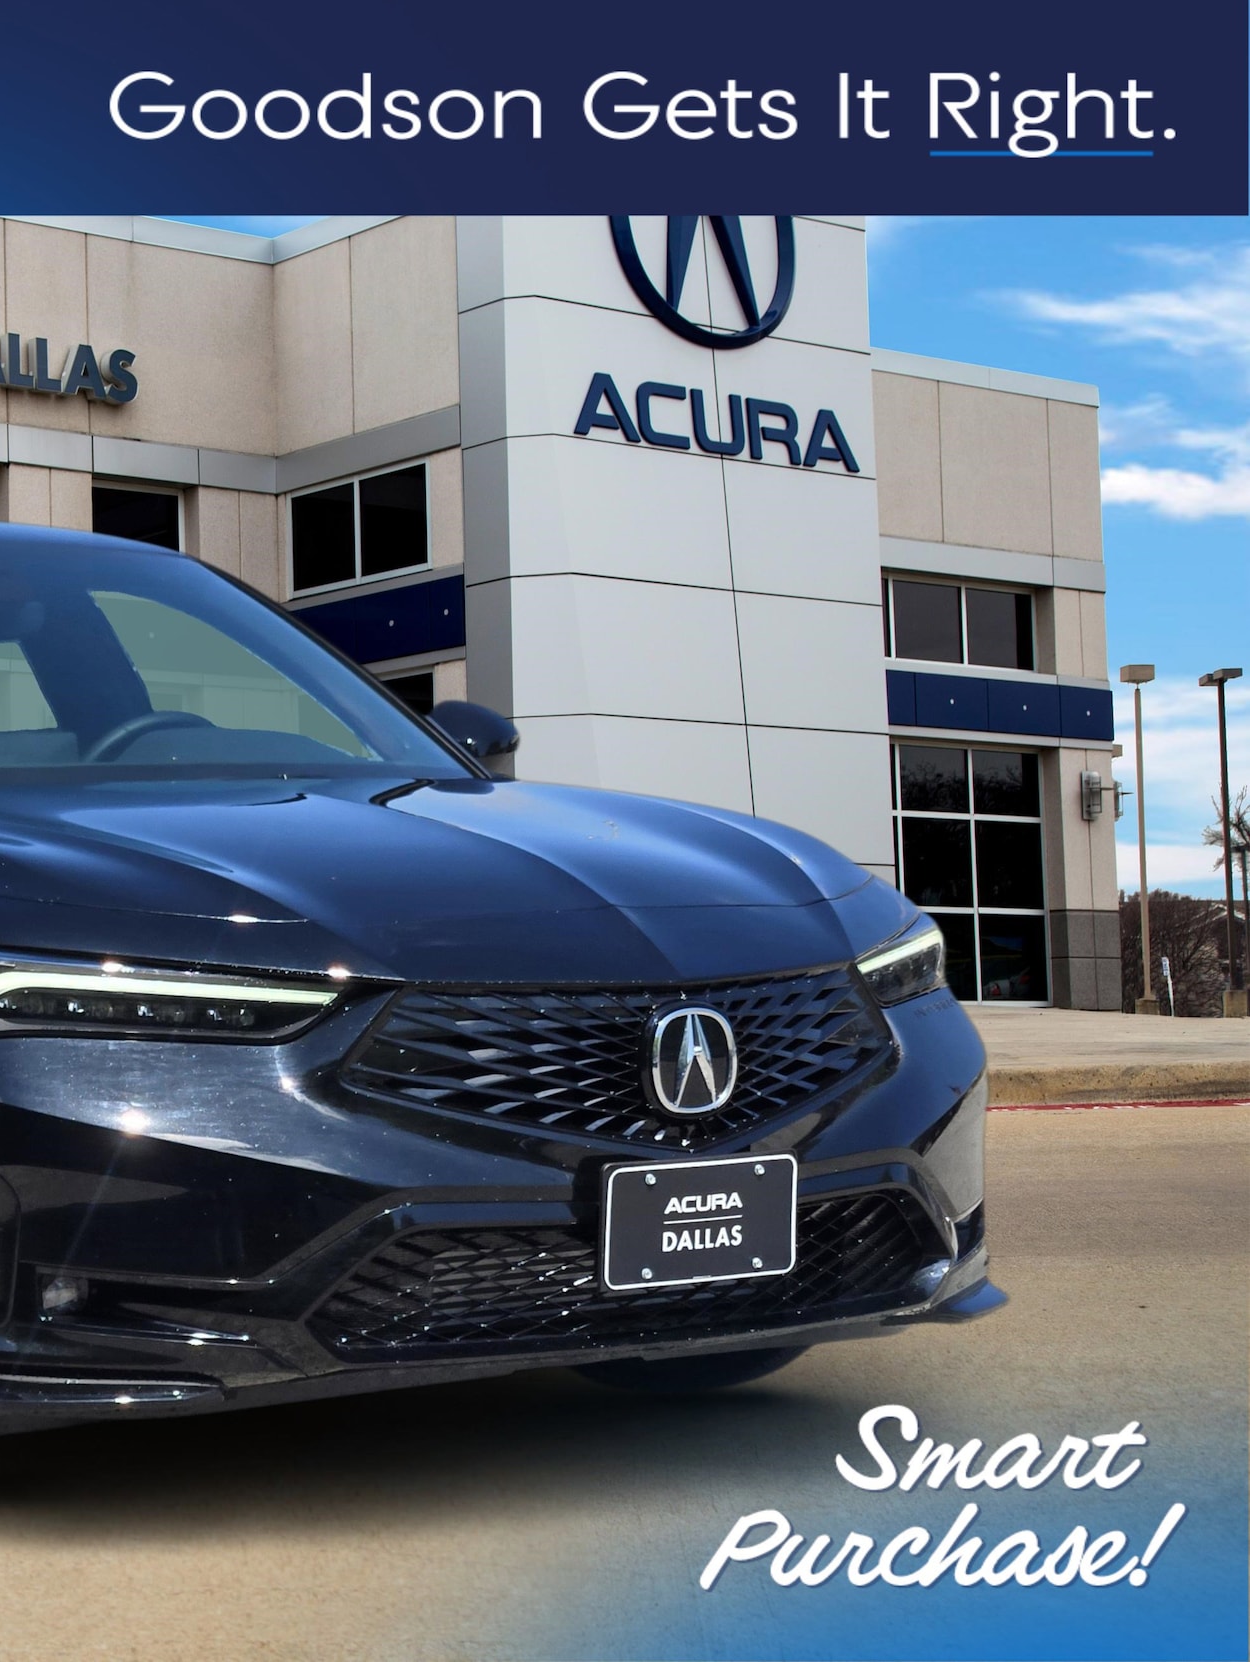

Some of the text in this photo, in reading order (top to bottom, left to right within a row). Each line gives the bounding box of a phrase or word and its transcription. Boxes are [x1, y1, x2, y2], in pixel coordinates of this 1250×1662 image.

[573, 372, 860, 473] ACURA
[663, 1191, 744, 1215] ACURA
[661, 1224, 743, 1253] DALLAS
